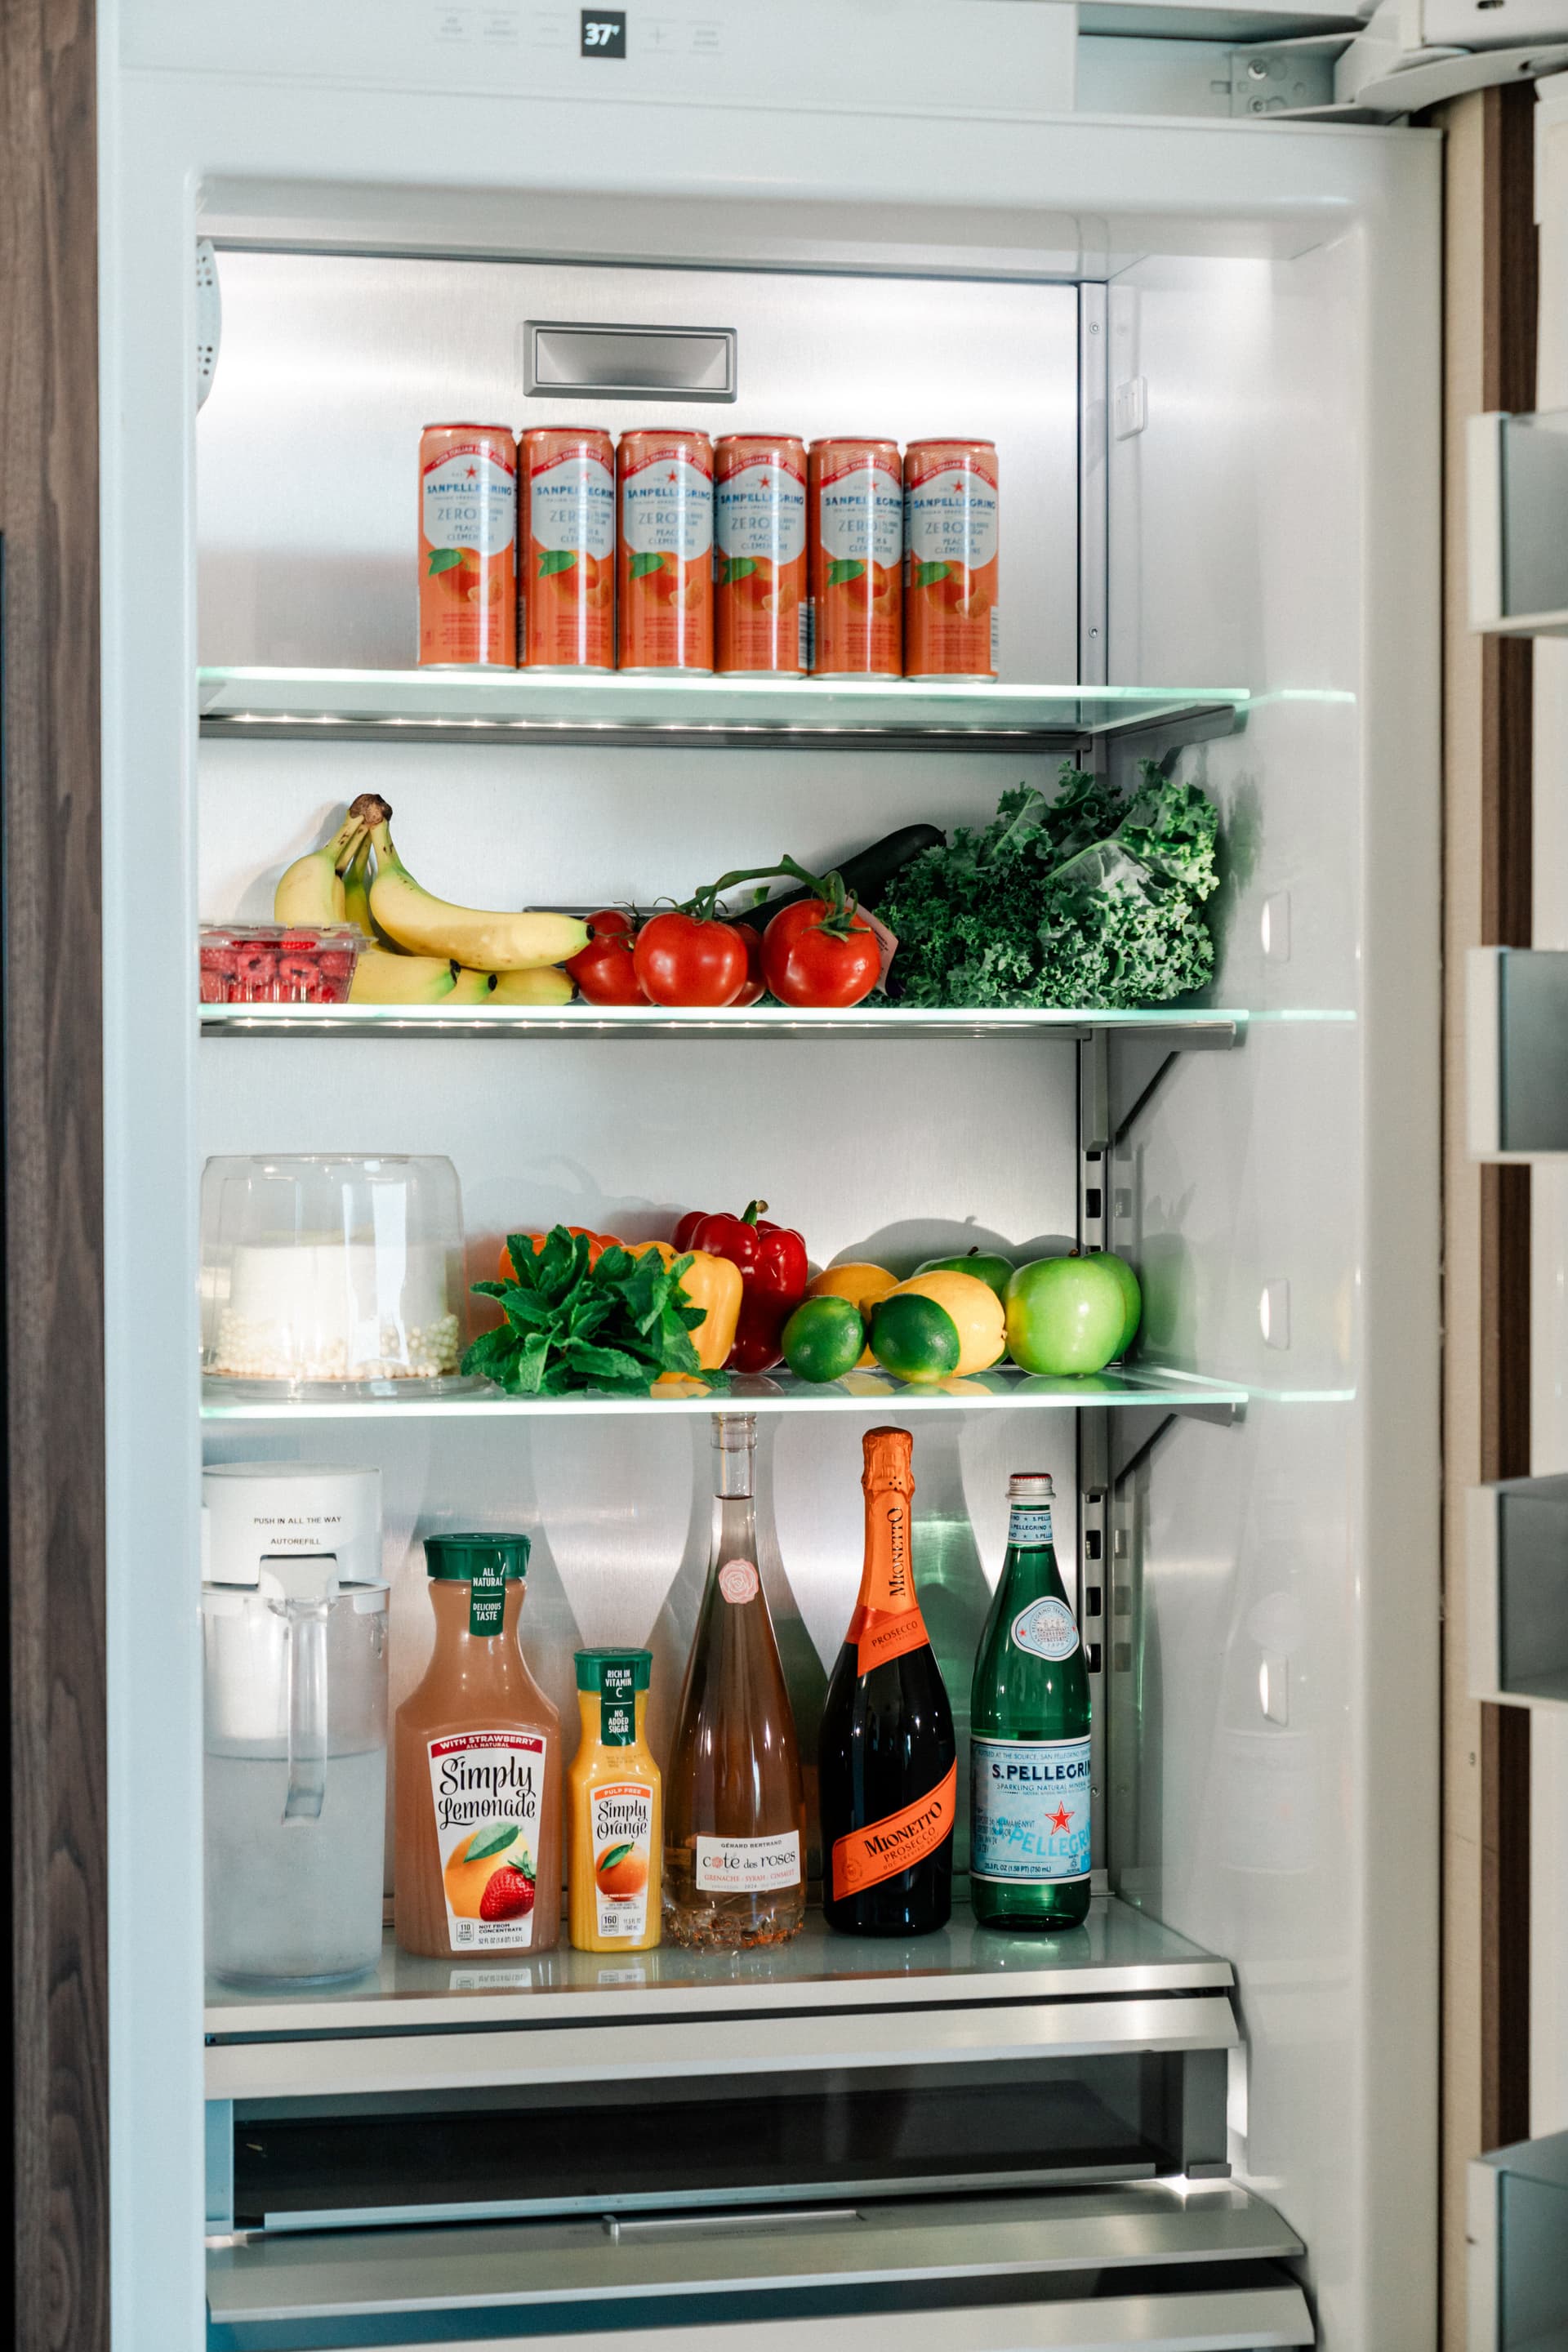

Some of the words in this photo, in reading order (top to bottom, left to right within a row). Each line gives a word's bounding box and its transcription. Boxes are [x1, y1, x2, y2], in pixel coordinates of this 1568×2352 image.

[427, 483, 512, 497] SANPELLERINO
[627, 488, 710, 501] SANPELLGRINO
[720, 493, 804, 506] SANPELLGRINO
[914, 497, 996, 510] SANPELLGRINO
[438, 508, 477, 520] ZERO
[639, 512, 678, 524] ZERO
[732, 517, 770, 530] ZERO
[925, 522, 964, 535] ZERO
[483, 1567, 495, 1577] ALL
[473, 1576, 503, 1587] NATURAL
[473, 1602, 501, 1610] DELICIOUS
[476, 1611, 497, 1621] TASTE
[871, 1620, 918, 1647] PROSECCO
[607, 1670, 622, 1678] RICH
[624, 1669, 630, 1677] IN
[605, 1678, 632, 1687] VITAMIN
[616, 1687, 622, 1698] C
[608, 1717, 629, 1726] ADDED
[608, 1725, 629, 1733] SUGAR
[439, 1737, 466, 1750] WITH
[469, 1735, 536, 1746] STRAWBERRY
[992, 1760, 1090, 1780] S.PELLEGRIN
[439, 1756, 537, 1797] Simply
[997, 1783, 1034, 1792] SPARKLING
[1037, 1783, 1067, 1791] NATURAL
[438, 1793, 536, 1830] Lemonade
[598, 1800, 648, 1822] Simply
[597, 1820, 648, 1841] Orange
[750, 1840, 782, 1848] BERTRAND
[883, 1827, 935, 1863] PROSECCO
[744, 1858, 758, 1869] des
[760, 1851, 795, 1868] roses
[705, 1874, 739, 1882] GRENACHE
[604, 1915, 617, 1924] 160
